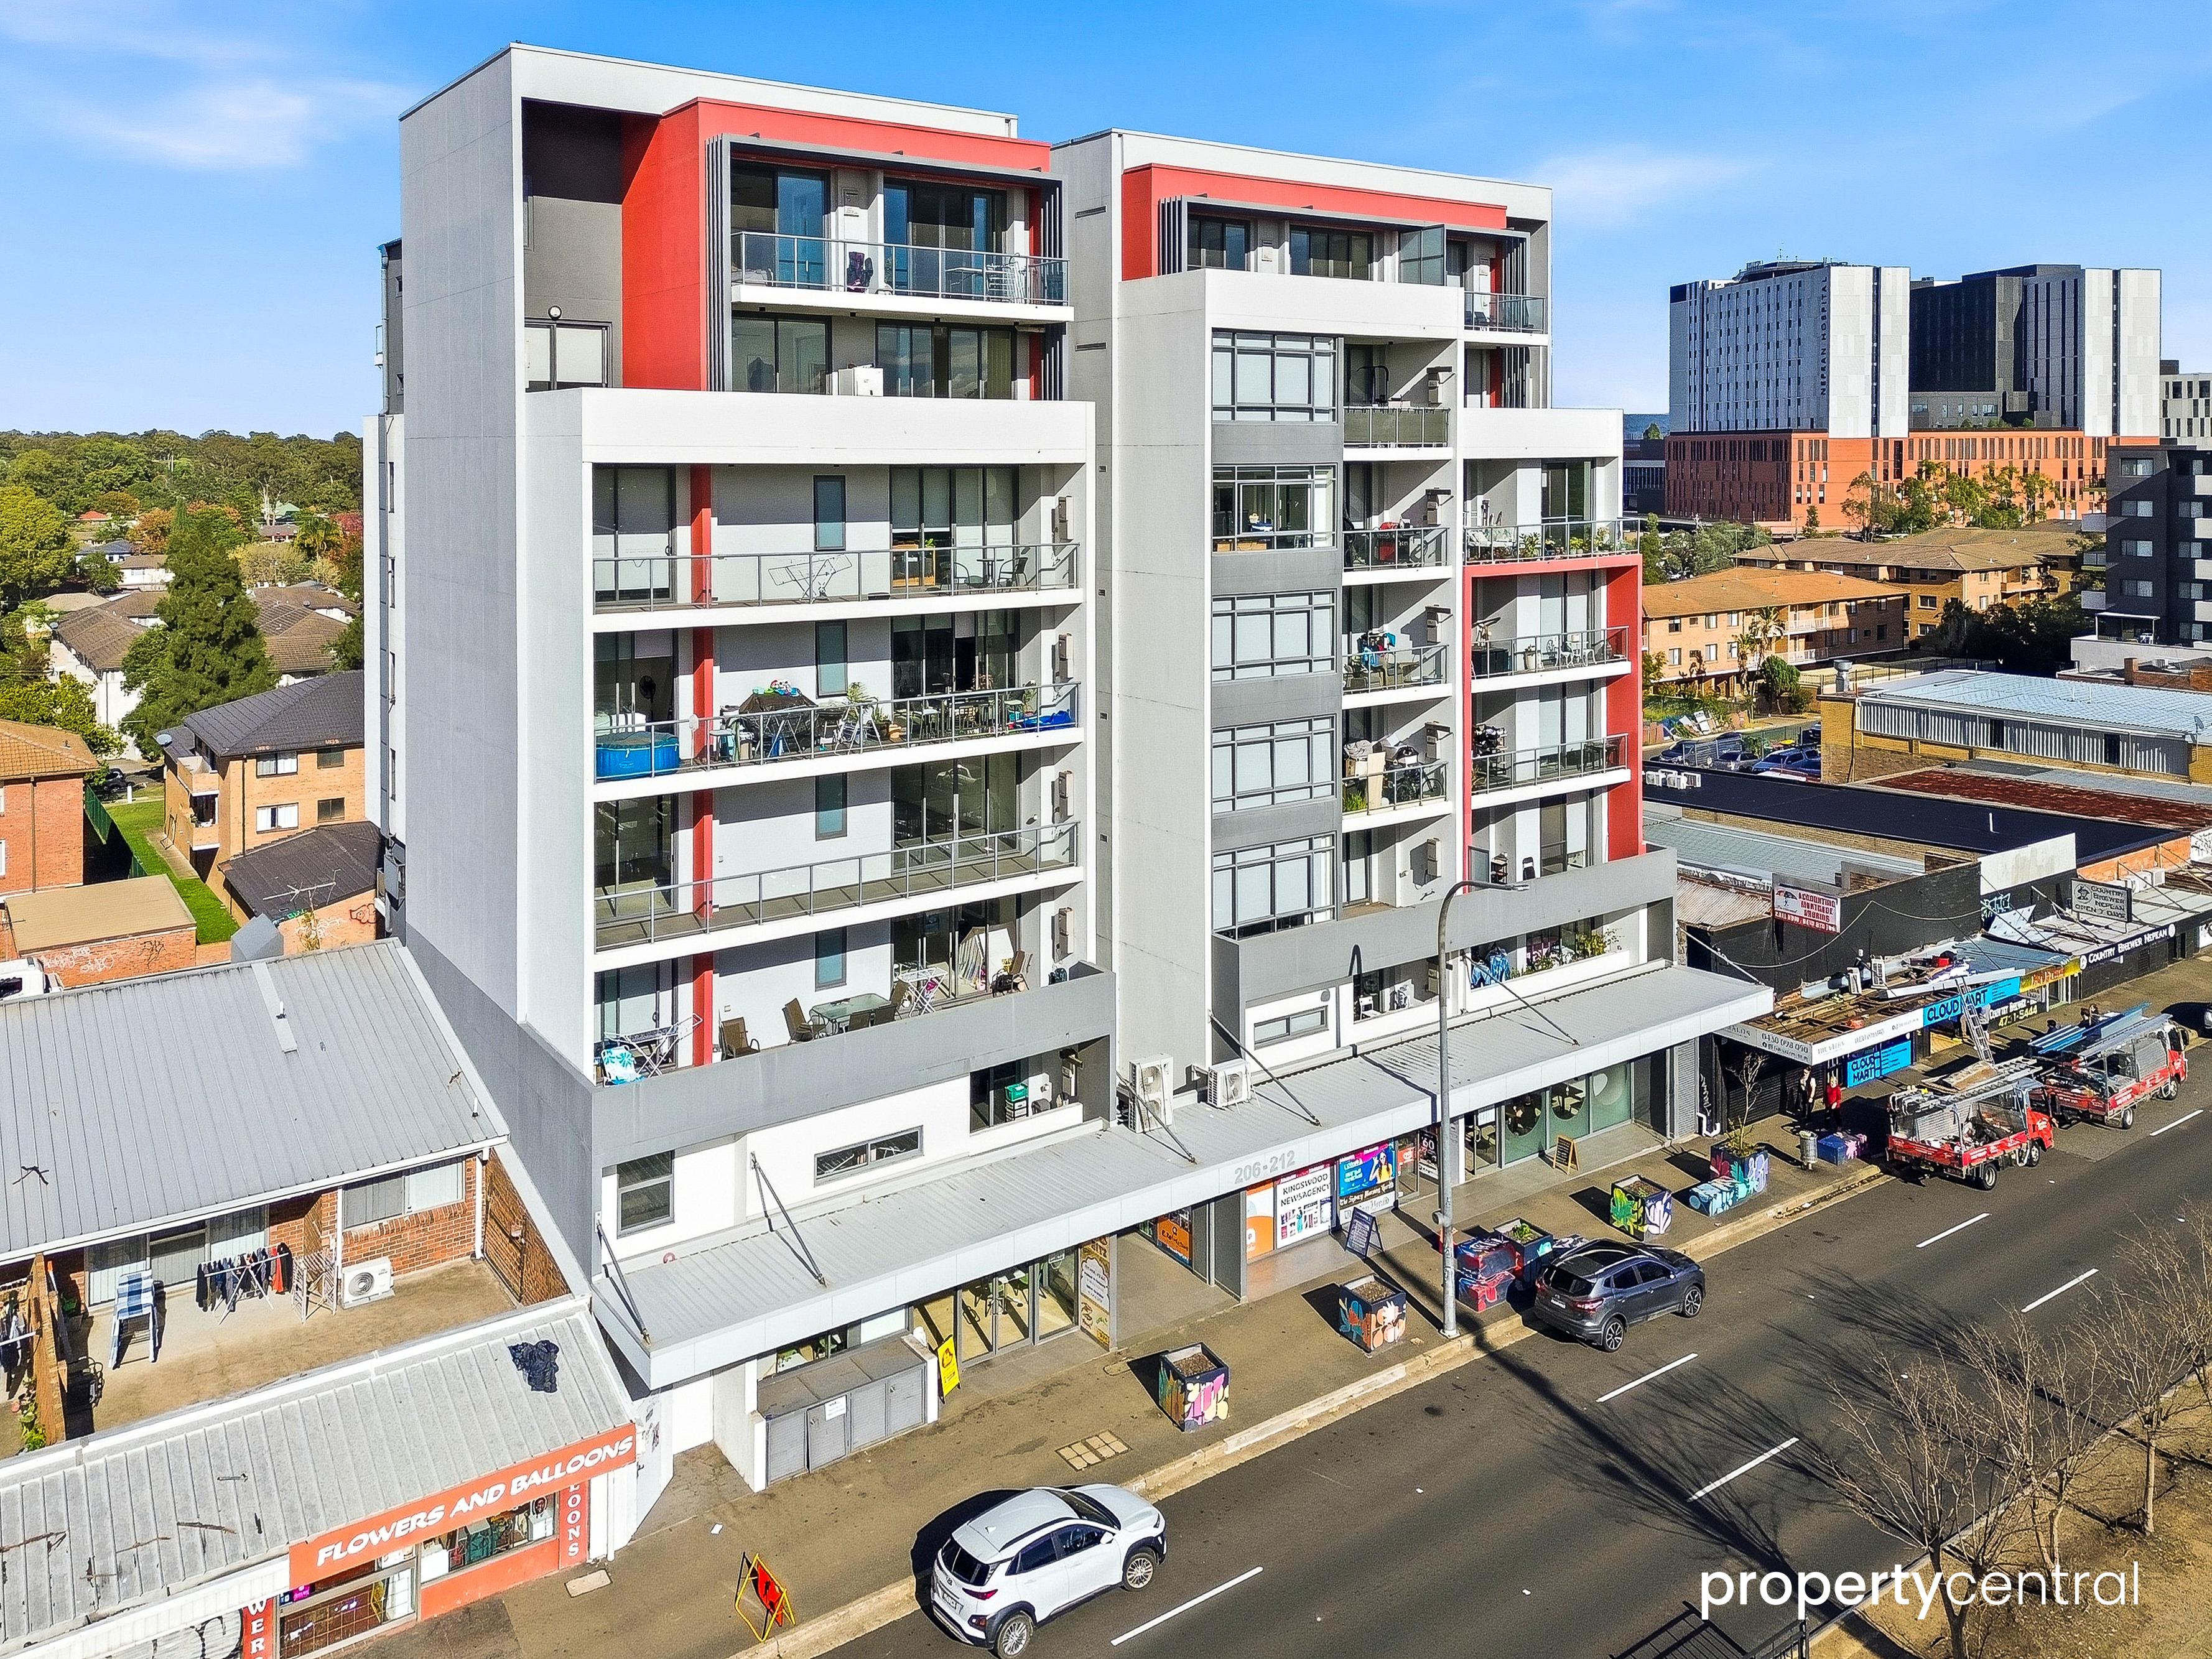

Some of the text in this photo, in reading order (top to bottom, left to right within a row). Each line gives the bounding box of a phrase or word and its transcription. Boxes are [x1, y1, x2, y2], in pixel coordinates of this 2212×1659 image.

[1927, 999, 1959, 1022] CLOUD
[1281, 1183, 1331, 1207] NEWSAGENCY
[1283, 1173, 1328, 1196] KINGSWOOD
[317, 1434, 634, 1567] FLOWERS AND BALLOONS
[248, 1597, 267, 1659] WER
